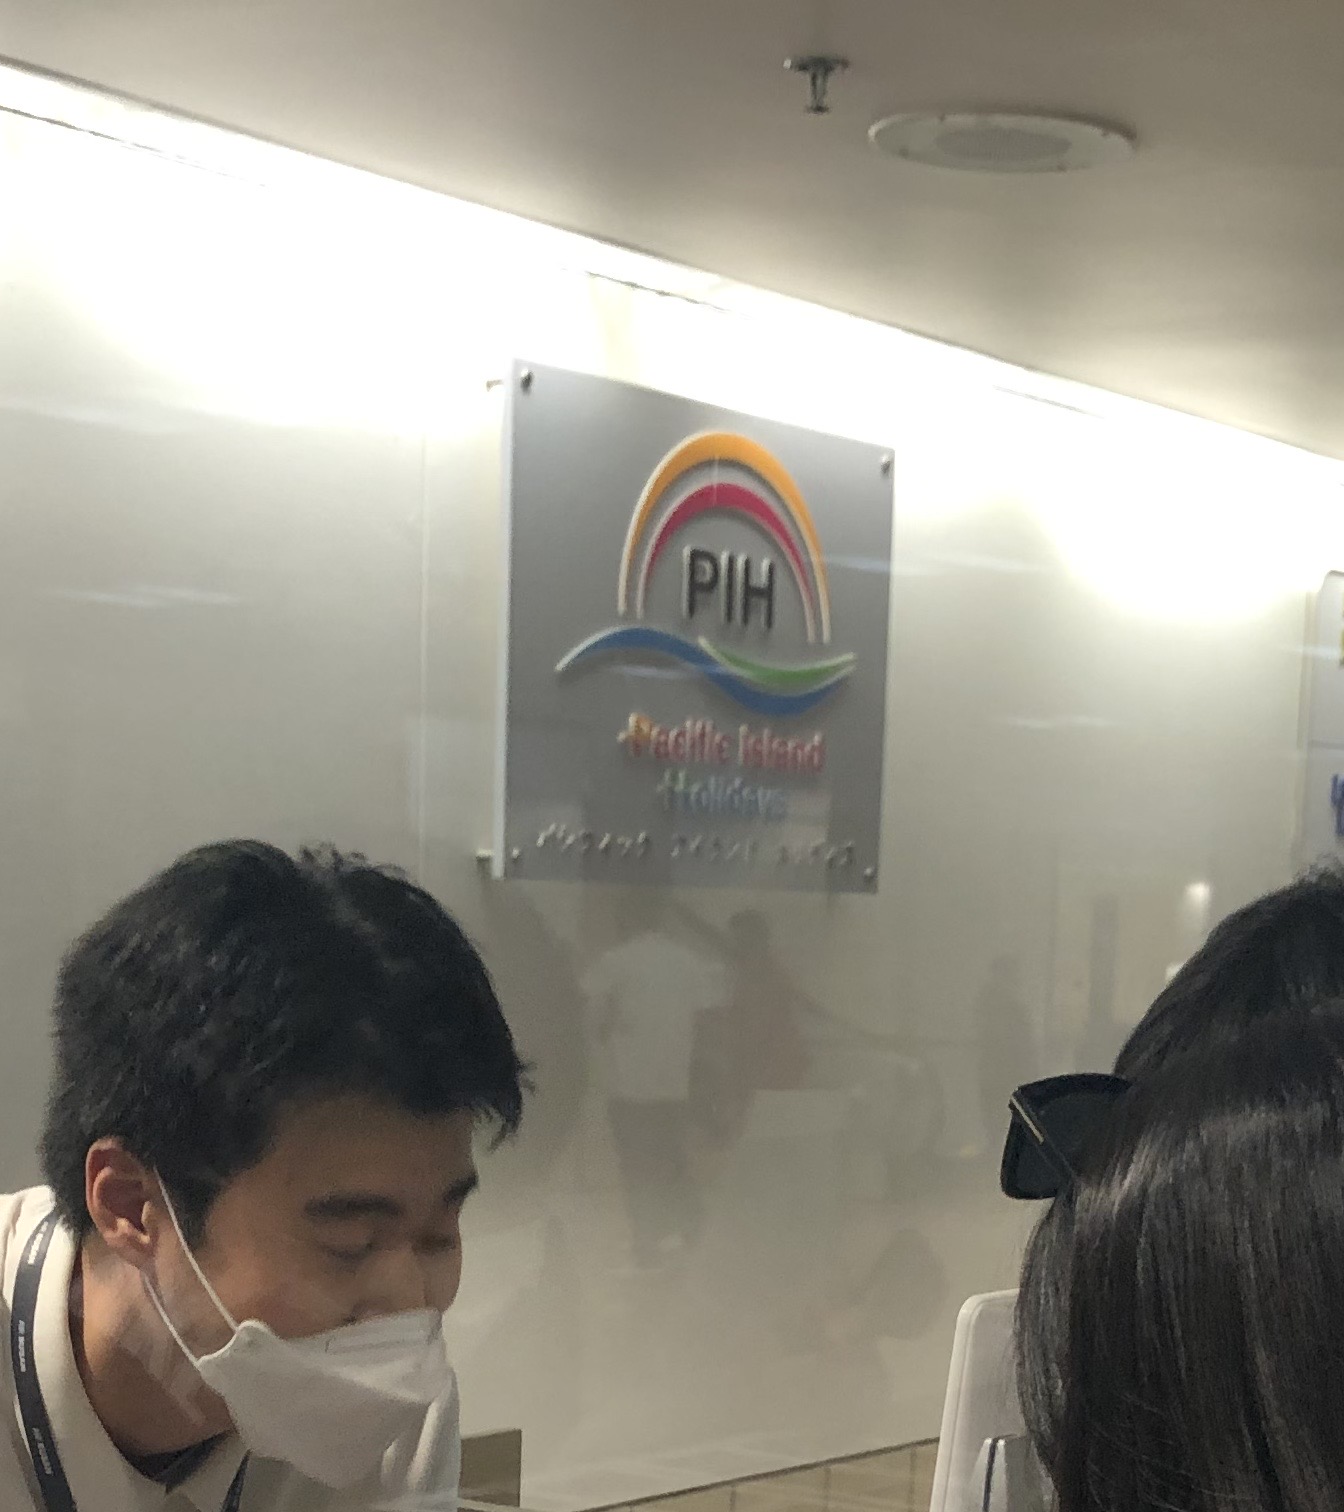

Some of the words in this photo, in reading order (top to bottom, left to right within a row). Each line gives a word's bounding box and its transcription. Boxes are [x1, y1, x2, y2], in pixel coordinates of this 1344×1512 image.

[682, 545, 774, 629] PIH
[617, 712, 734, 766] Pacific
[738, 724, 827, 774] Island
